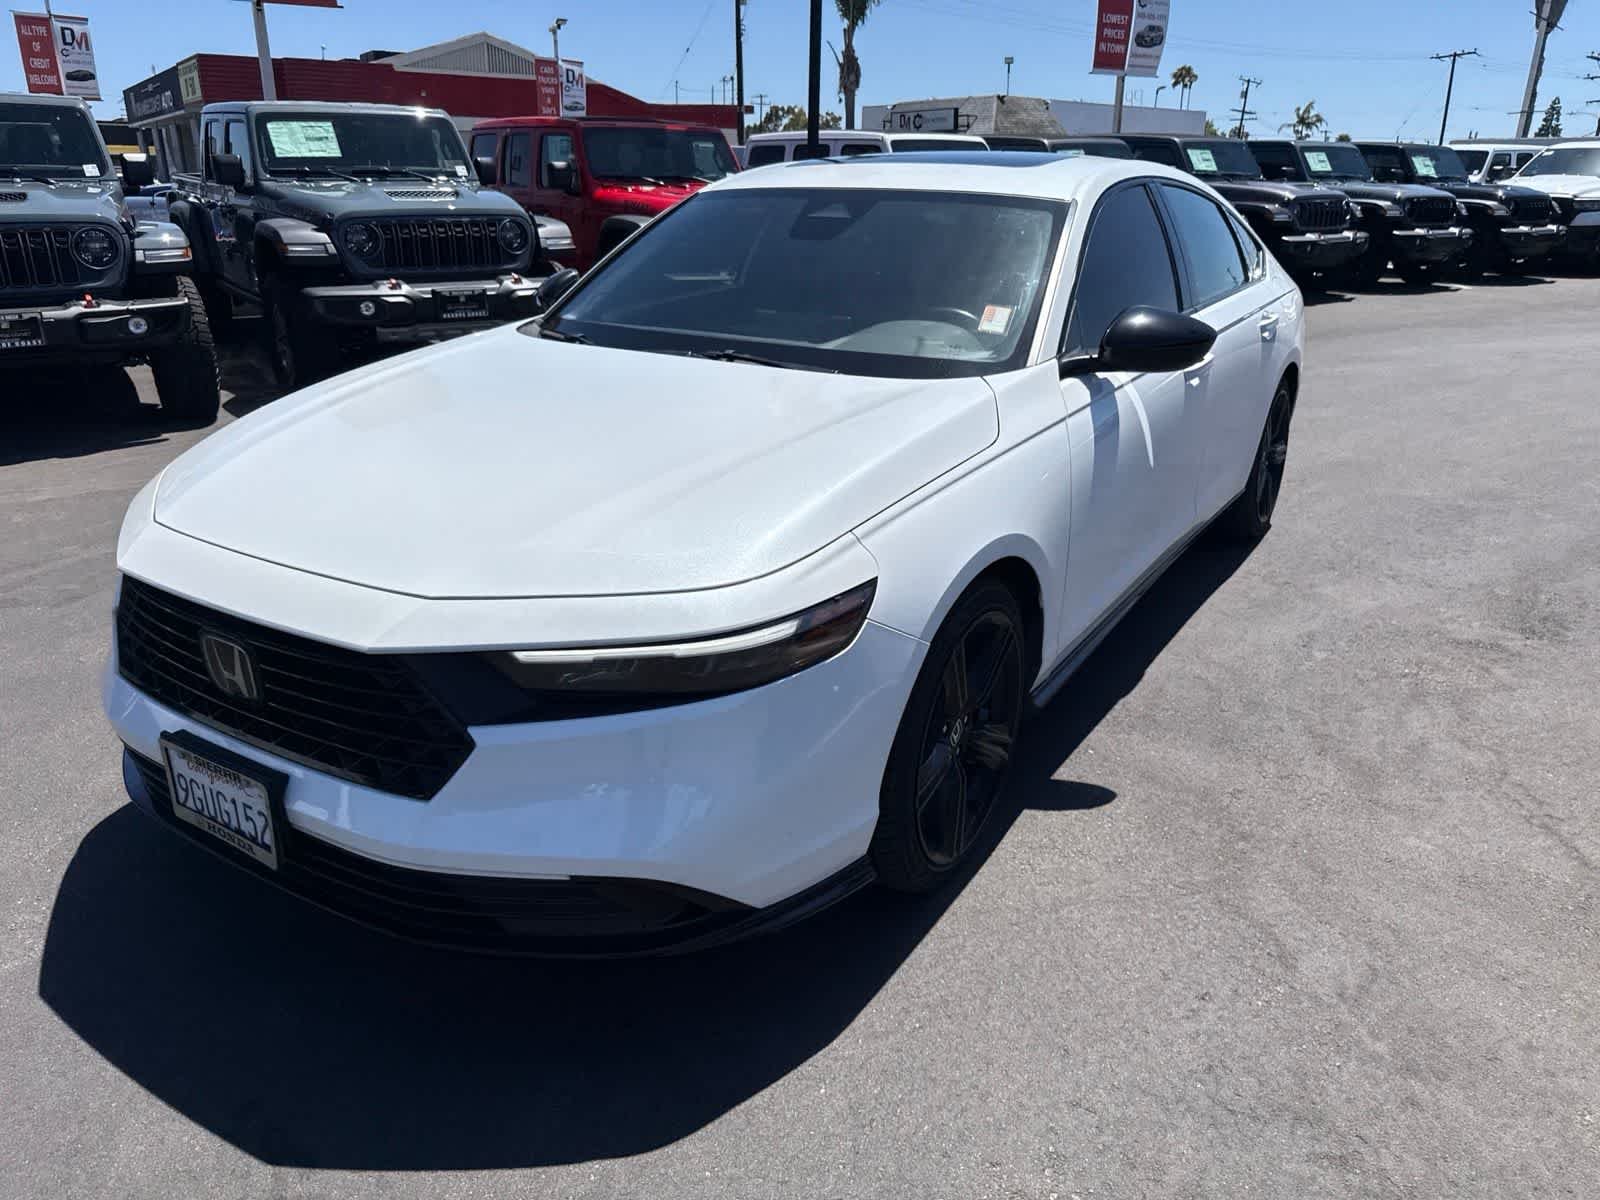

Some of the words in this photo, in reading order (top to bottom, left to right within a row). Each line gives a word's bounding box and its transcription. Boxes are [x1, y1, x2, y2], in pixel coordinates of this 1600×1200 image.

[1103, 13, 1129, 25] LOWEST
[21, 24, 32, 36] ALL
[32, 25, 48, 36] TYPE
[1103, 28, 1125, 40] PRICES
[32, 41, 41, 52] OF
[1099, 42, 1107, 53] IN
[1107, 43, 1126, 54] TOWN
[29, 57, 50, 69] CREDIT
[540, 66, 554, 74] CARS
[28, 74, 58, 86] WELCOME
[176, 772, 271, 853] 9GUG152
[207, 822, 257, 855] HONDA
